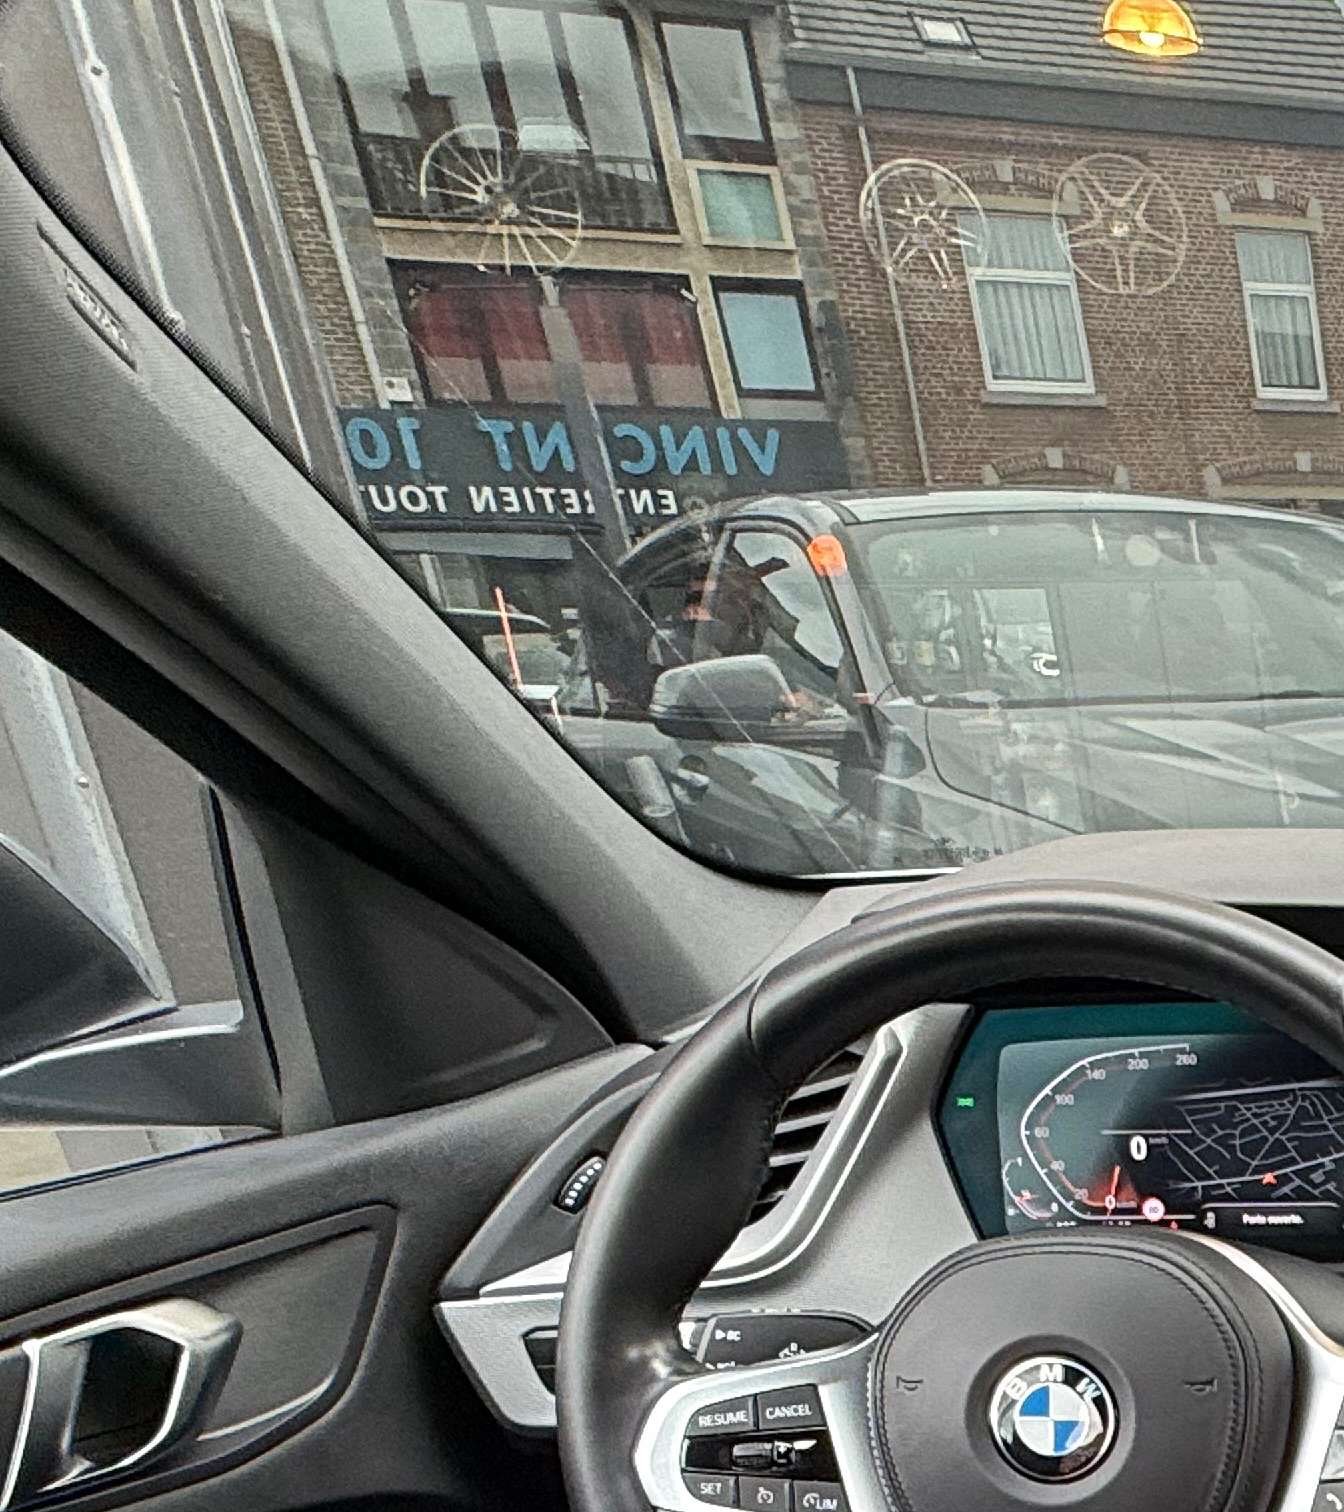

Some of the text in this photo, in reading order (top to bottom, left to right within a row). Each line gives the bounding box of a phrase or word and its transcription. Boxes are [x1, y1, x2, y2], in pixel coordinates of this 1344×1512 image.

[1129, 1135, 1148, 1161] 0
[1004, 1363, 1103, 1399] BMW
[698, 1410, 750, 1428] RESUME
[765, 1403, 813, 1420] CANCEL
[699, 1482, 722, 1494] SET
